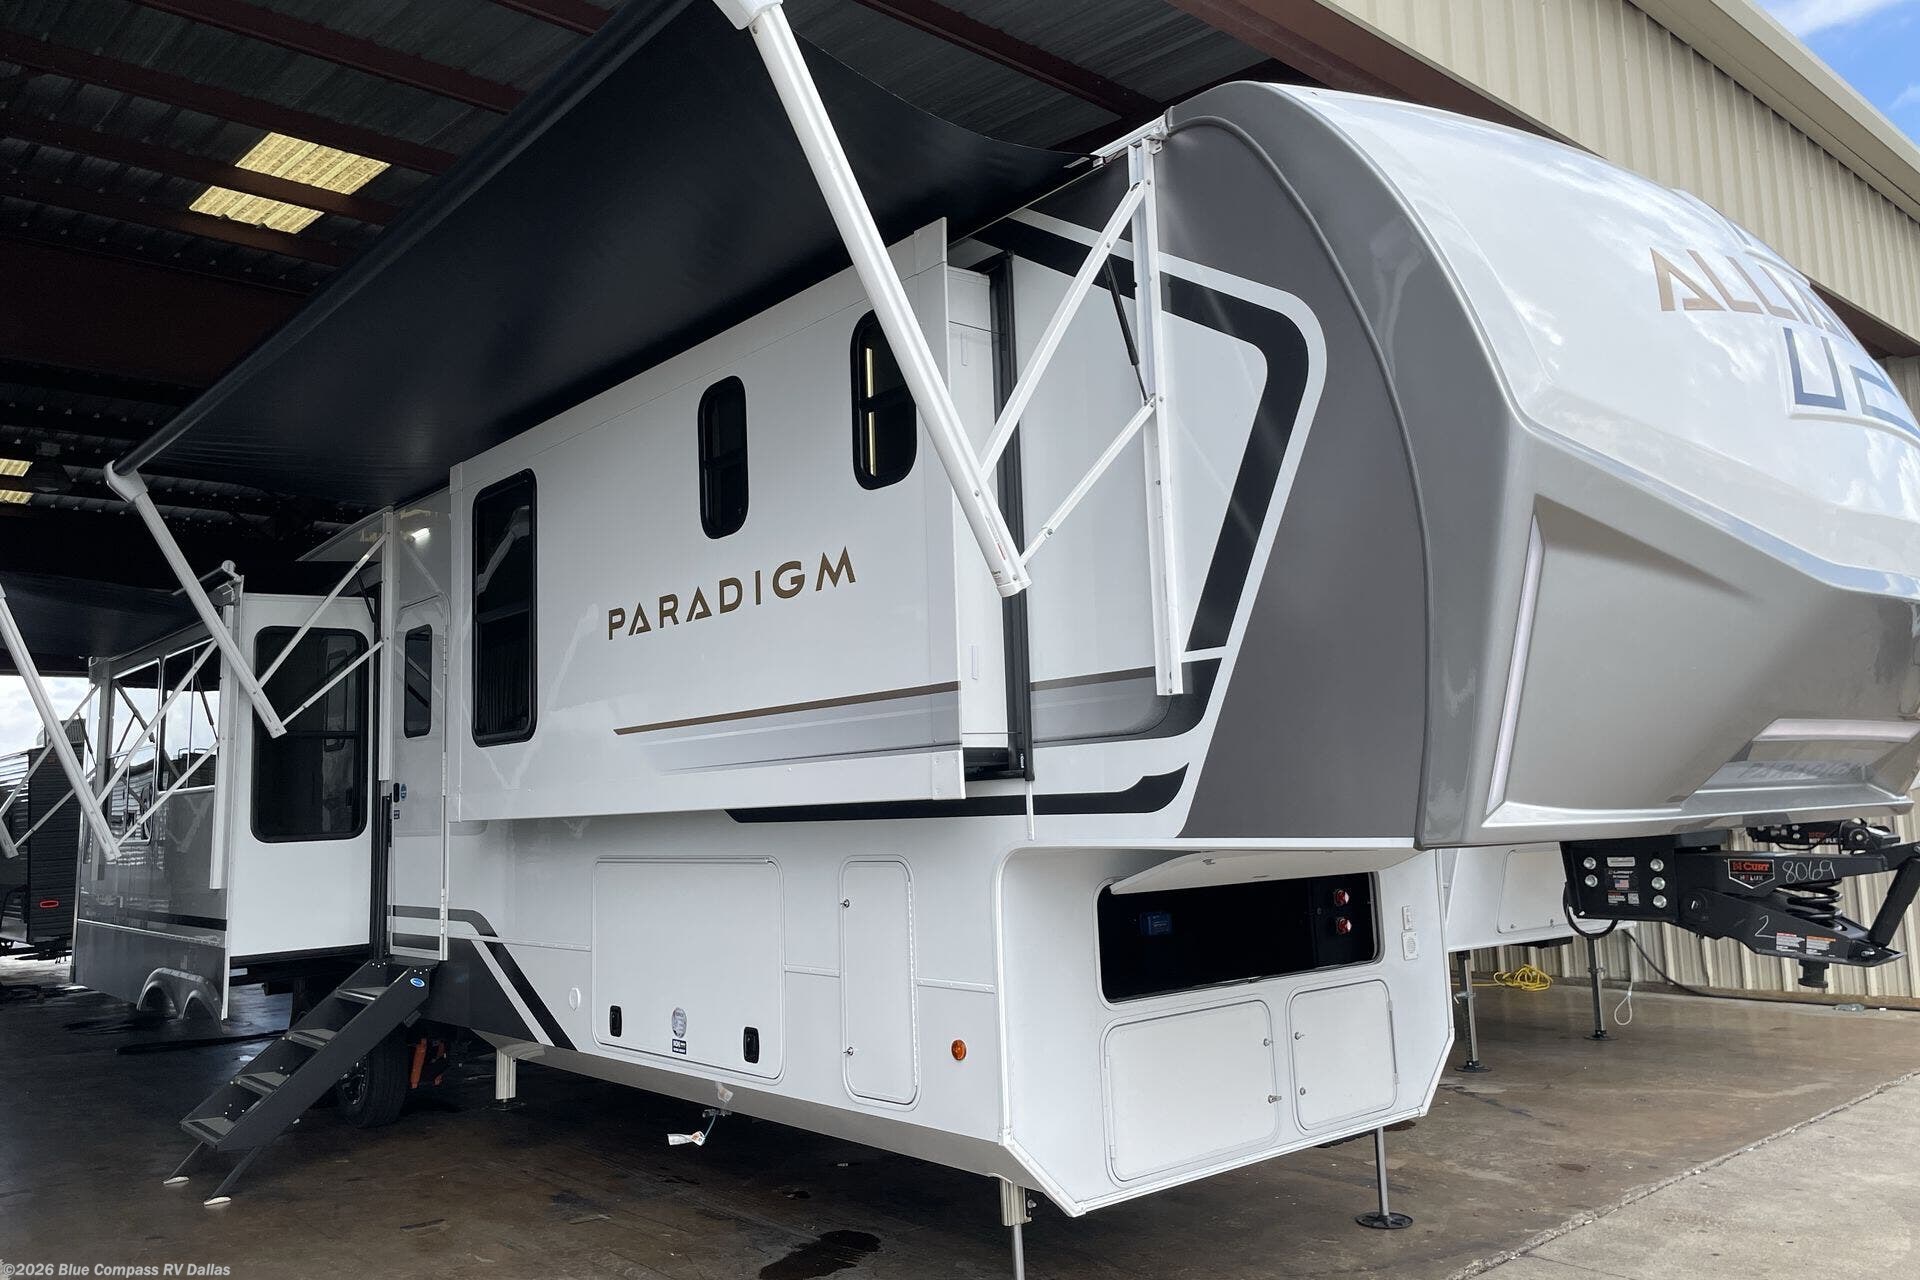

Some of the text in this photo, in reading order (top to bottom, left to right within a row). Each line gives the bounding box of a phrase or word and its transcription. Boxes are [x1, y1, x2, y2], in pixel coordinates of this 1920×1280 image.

[608, 545, 856, 640] PARADIGM
[1782, 860, 1836, 883] 8069
[1754, 915, 1777, 939] 2
